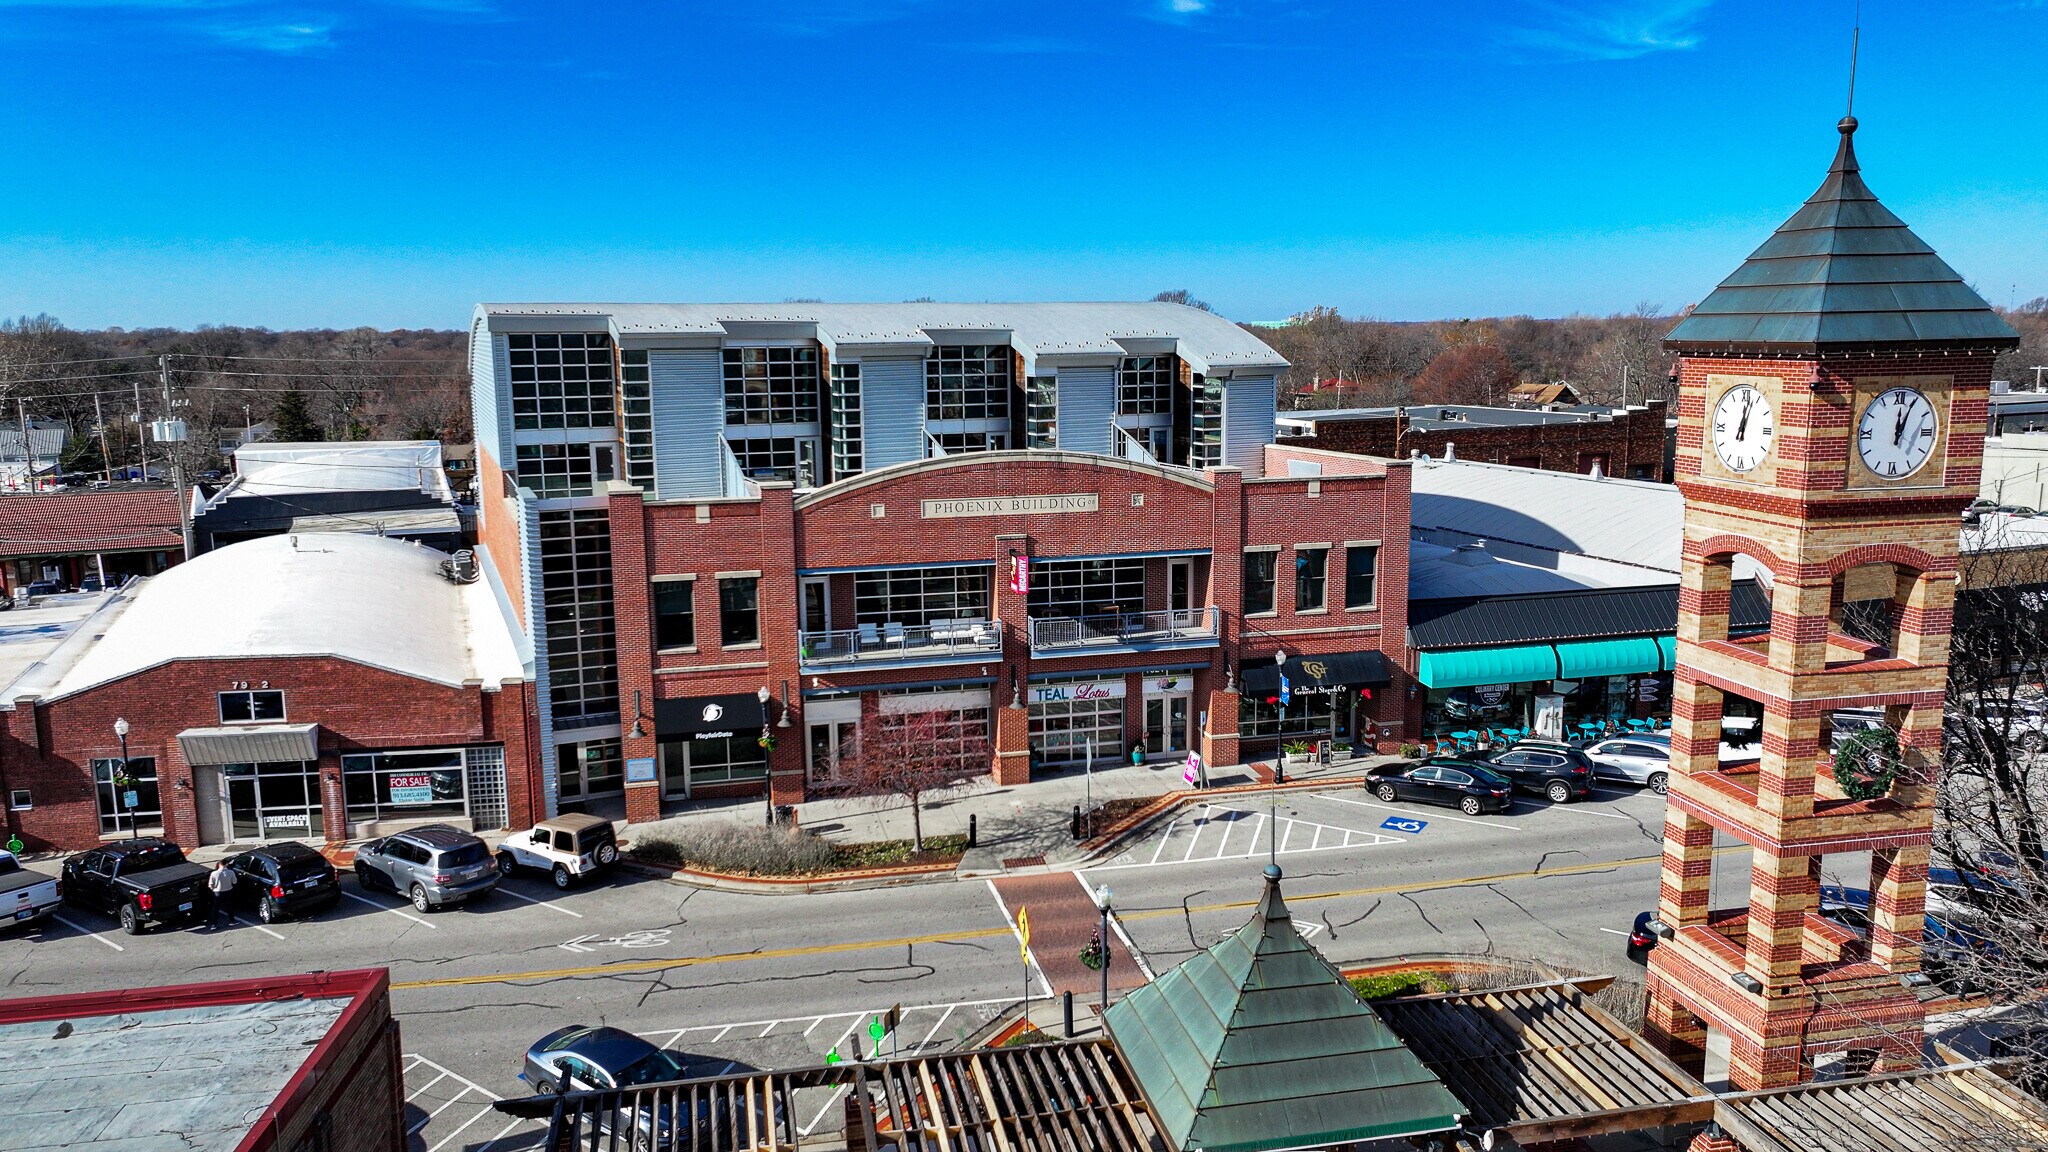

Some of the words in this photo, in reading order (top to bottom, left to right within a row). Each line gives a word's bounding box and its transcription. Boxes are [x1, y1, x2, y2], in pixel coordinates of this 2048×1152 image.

[1893, 392, 1907, 405] XII
[1860, 428, 1872, 440] IX
[1920, 427, 1932, 438] III
[1887, 462, 1897, 475] VI
[934, 501, 1003, 514] PHOENIX
[1011, 497, 1086, 511] BUILDING
[1036, 687, 1069, 701] TEAL
[1073, 683, 1110, 700] Lotus
[390, 778, 408, 786] FOR
[409, 776, 430, 786] SALE
